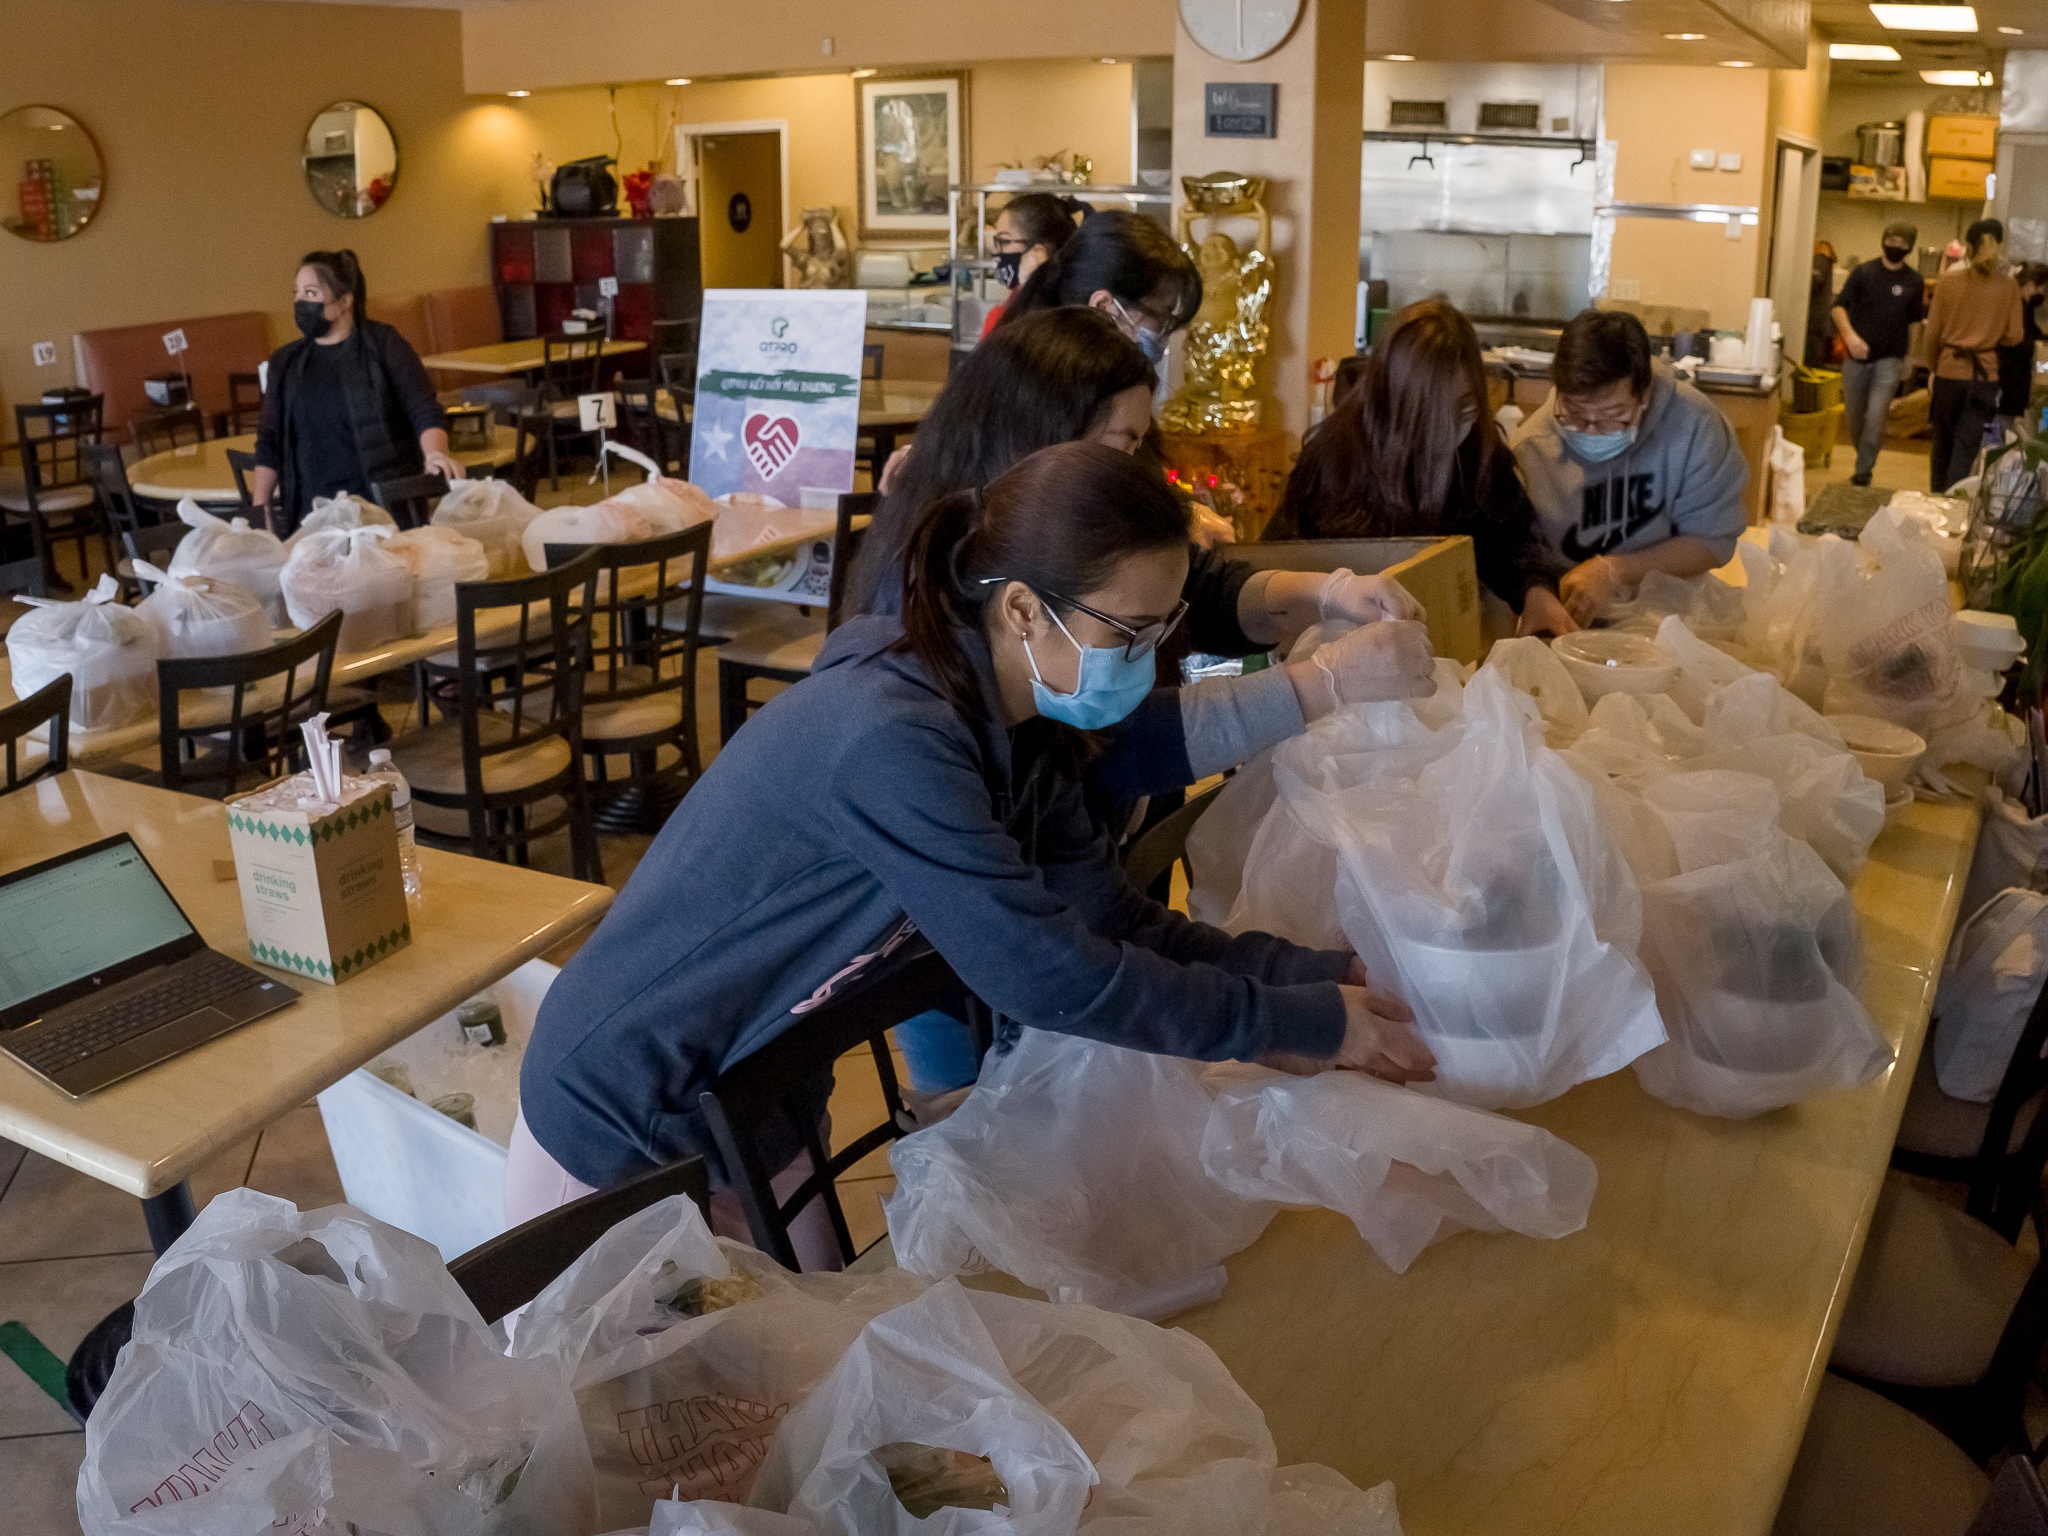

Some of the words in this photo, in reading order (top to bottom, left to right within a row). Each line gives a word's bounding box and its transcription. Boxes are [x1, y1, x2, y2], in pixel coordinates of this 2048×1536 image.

[591, 399, 604, 423] 7
[252, 871, 297, 894] drinking
[339, 858, 384, 886] drinking
[255, 884, 290, 901] straws
[340, 876, 377, 899] straws
